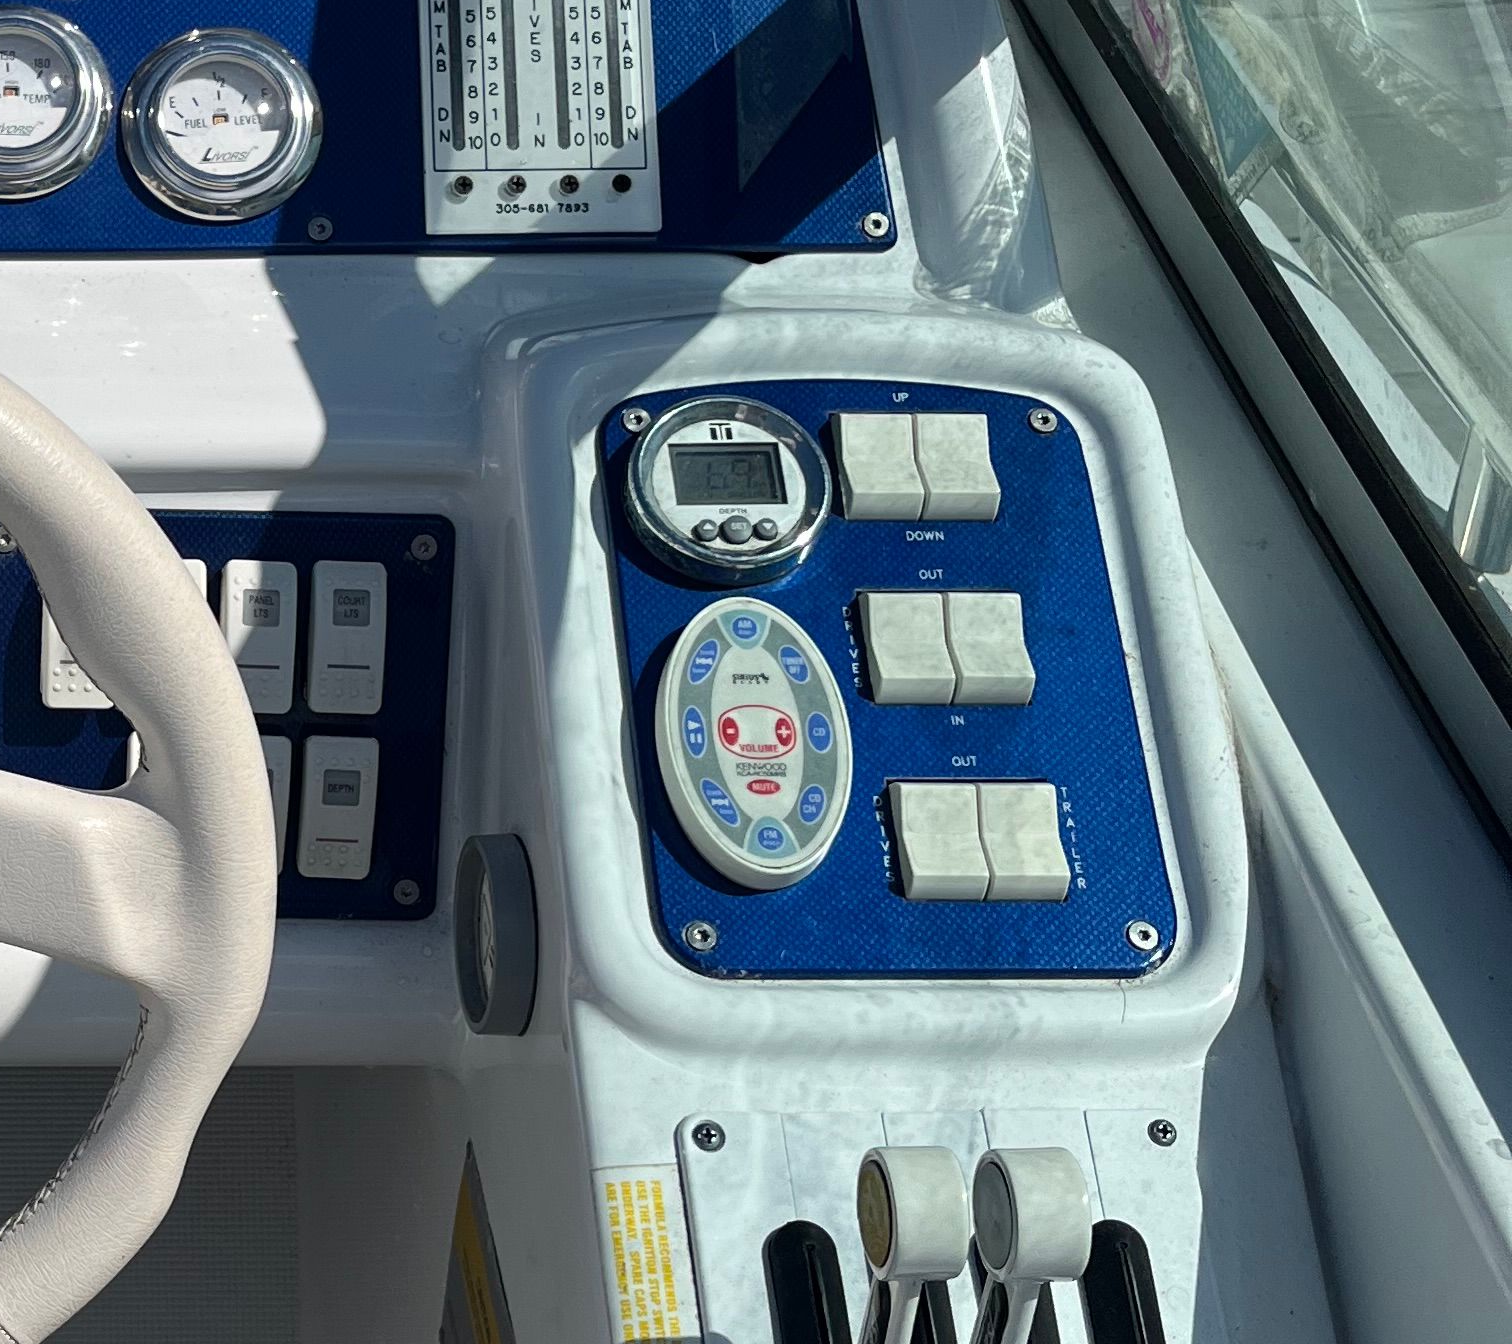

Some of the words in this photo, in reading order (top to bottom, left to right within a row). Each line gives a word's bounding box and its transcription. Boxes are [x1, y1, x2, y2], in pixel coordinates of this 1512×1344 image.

[466, 10, 475, 23] 5
[466, 35, 476, 47] 6
[621, 23, 633, 69] TAB
[435, 25, 446, 72] TAB
[467, 60, 476, 72] 7
[23, 93, 50, 103] TEMP
[468, 86, 478, 98] 8
[170, 97, 175, 108] E
[184, 120, 207, 128] FUEL
[234, 116, 263, 125] LEVEL
[469, 111, 479, 123] 9
[469, 137, 482, 149] 10
[496, 204, 549, 213] 305-681
[558, 203, 589, 213] 7893
[893, 393, 909, 402] UP
[906, 531, 944, 541] DOWN
[919, 570, 943, 580] OUT
[249, 596, 274, 605] PANEL
[254, 609, 269, 618] LTS
[344, 610, 359, 618] LTS
[843, 607, 863, 688] DRIVES
[951, 716, 964, 725] IN
[813, 728, 825, 736] CD
[740, 744, 779, 752] VOLUME
[952, 756, 977, 767] OUT
[328, 784, 354, 793] DEPTH
[752, 783, 776, 791] MUTE
[764, 830, 778, 838] FM
[873, 796, 895, 882] DRIVES
[1061, 787, 1087, 889] TRAILER
[605, 1183, 617, 1203] ARE
[636, 1180, 647, 1200] USE
[609, 1206, 620, 1226] FOR
[639, 1204, 650, 1224] THE
[642, 1228, 657, 1274] IGNITION
[650, 1180, 666, 1231] FORMULA
[658, 1235, 677, 1312] RECOMMENDS
[669, 1317, 680, 1336] THE
[630, 1251, 643, 1284] SPARE
[649, 1279, 661, 1305] STOP
[634, 1289, 647, 1316] CAPS
